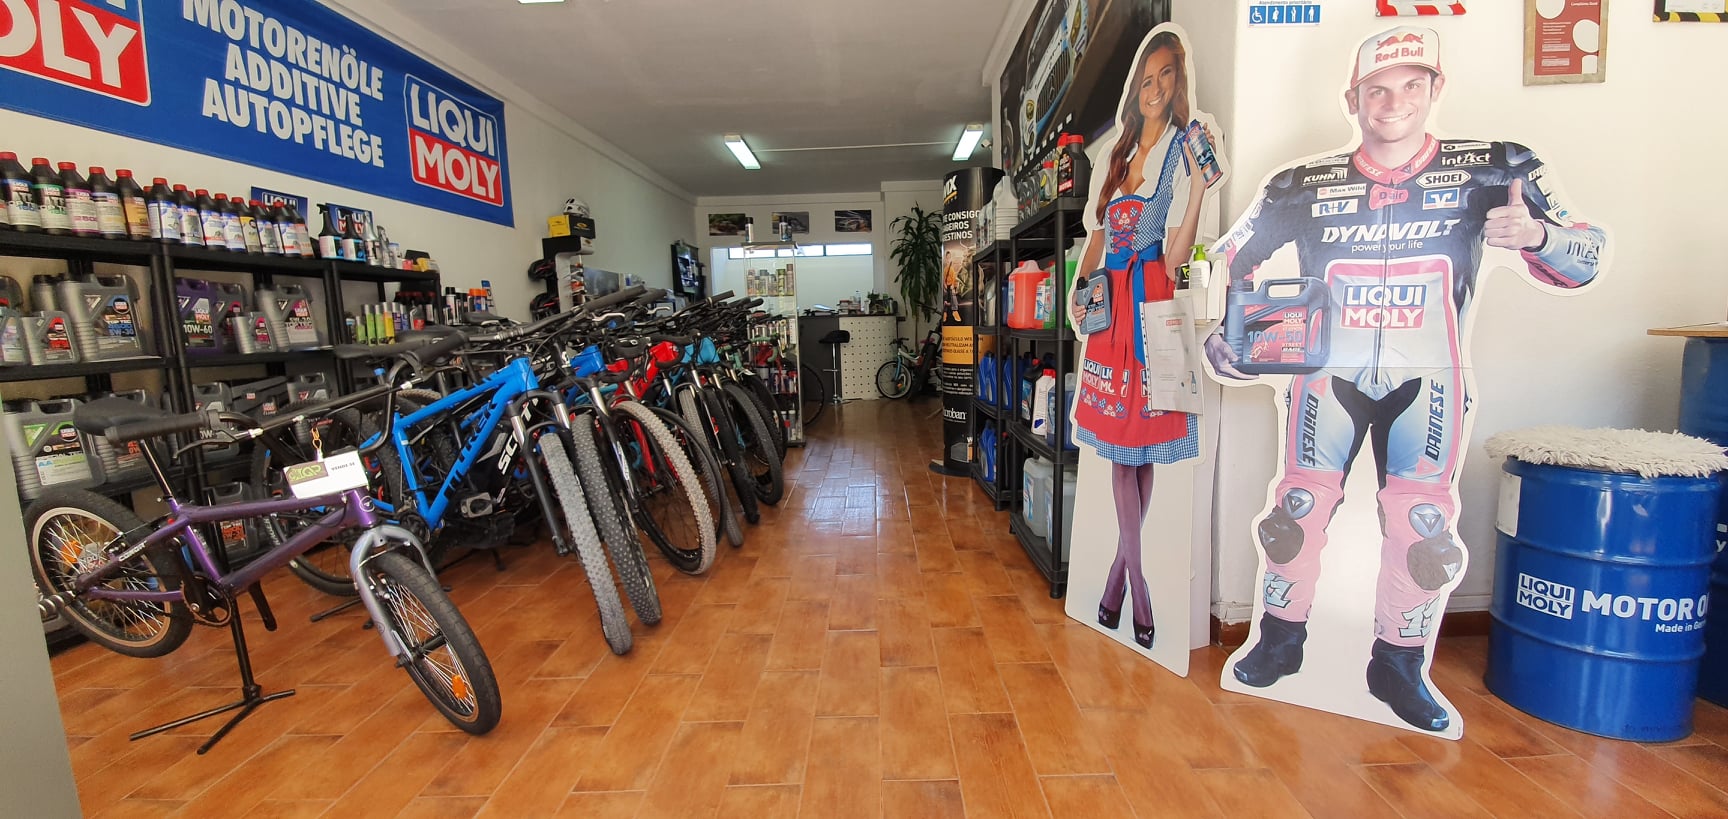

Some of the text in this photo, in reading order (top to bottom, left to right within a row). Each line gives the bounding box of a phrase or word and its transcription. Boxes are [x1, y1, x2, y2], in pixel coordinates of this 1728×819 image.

[183, 0, 384, 101] MOTORENÖLE
[1375, 46, 1424, 63] Red Bull
[225, 43, 363, 127] ADDITIVE
[202, 78, 384, 168] AUTOPFLEGE
[410, 83, 495, 157] LIQUI
[415, 135, 499, 199] MOLY
[1303, 173, 1338, 184] KUHN
[1425, 173, 1462, 185] SHOEI
[1319, 201, 1350, 215] R+V
[1321, 219, 1461, 243] DYNAVOLT
[1407, 240, 1424, 249] life
[1346, 285, 1424, 306] LIQUI
[1284, 311, 1303, 319] LIQUI
[1344, 308, 1422, 328] MOLY
[183, 324, 213, 334] 10W-60
[1247, 329, 1303, 344] 10W-50
[1521, 576, 1571, 600] LIQUI
[1519, 591, 1570, 616] MOLY
[1582, 590, 1694, 621] MOTOR
[1655, 624, 1683, 633] Made
[1685, 623, 1693, 632] in
